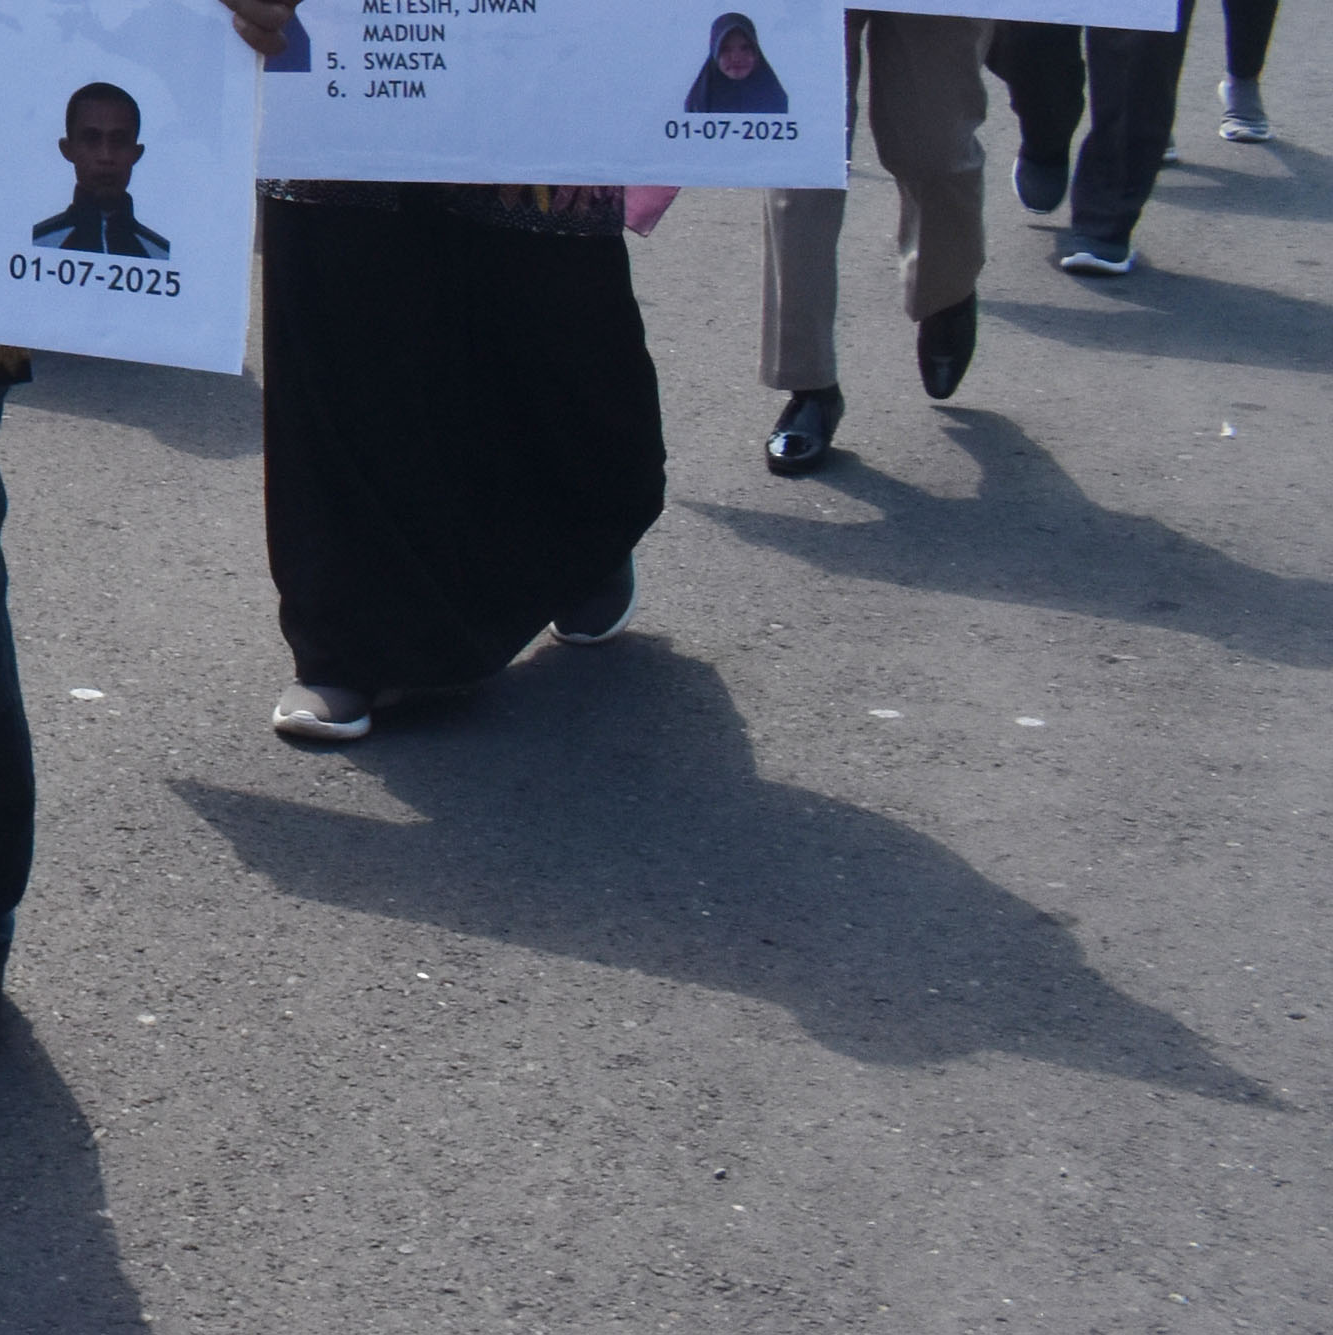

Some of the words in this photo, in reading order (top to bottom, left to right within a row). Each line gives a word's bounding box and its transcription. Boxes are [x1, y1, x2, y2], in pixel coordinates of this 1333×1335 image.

[363, 24, 445, 43] MADIUN
[364, 51, 446, 71] SWASTA
[365, 80, 425, 99] JATIM
[665, 120, 798, 140] 01-07-2025
[9, 254, 181, 297] 01-07-2025
